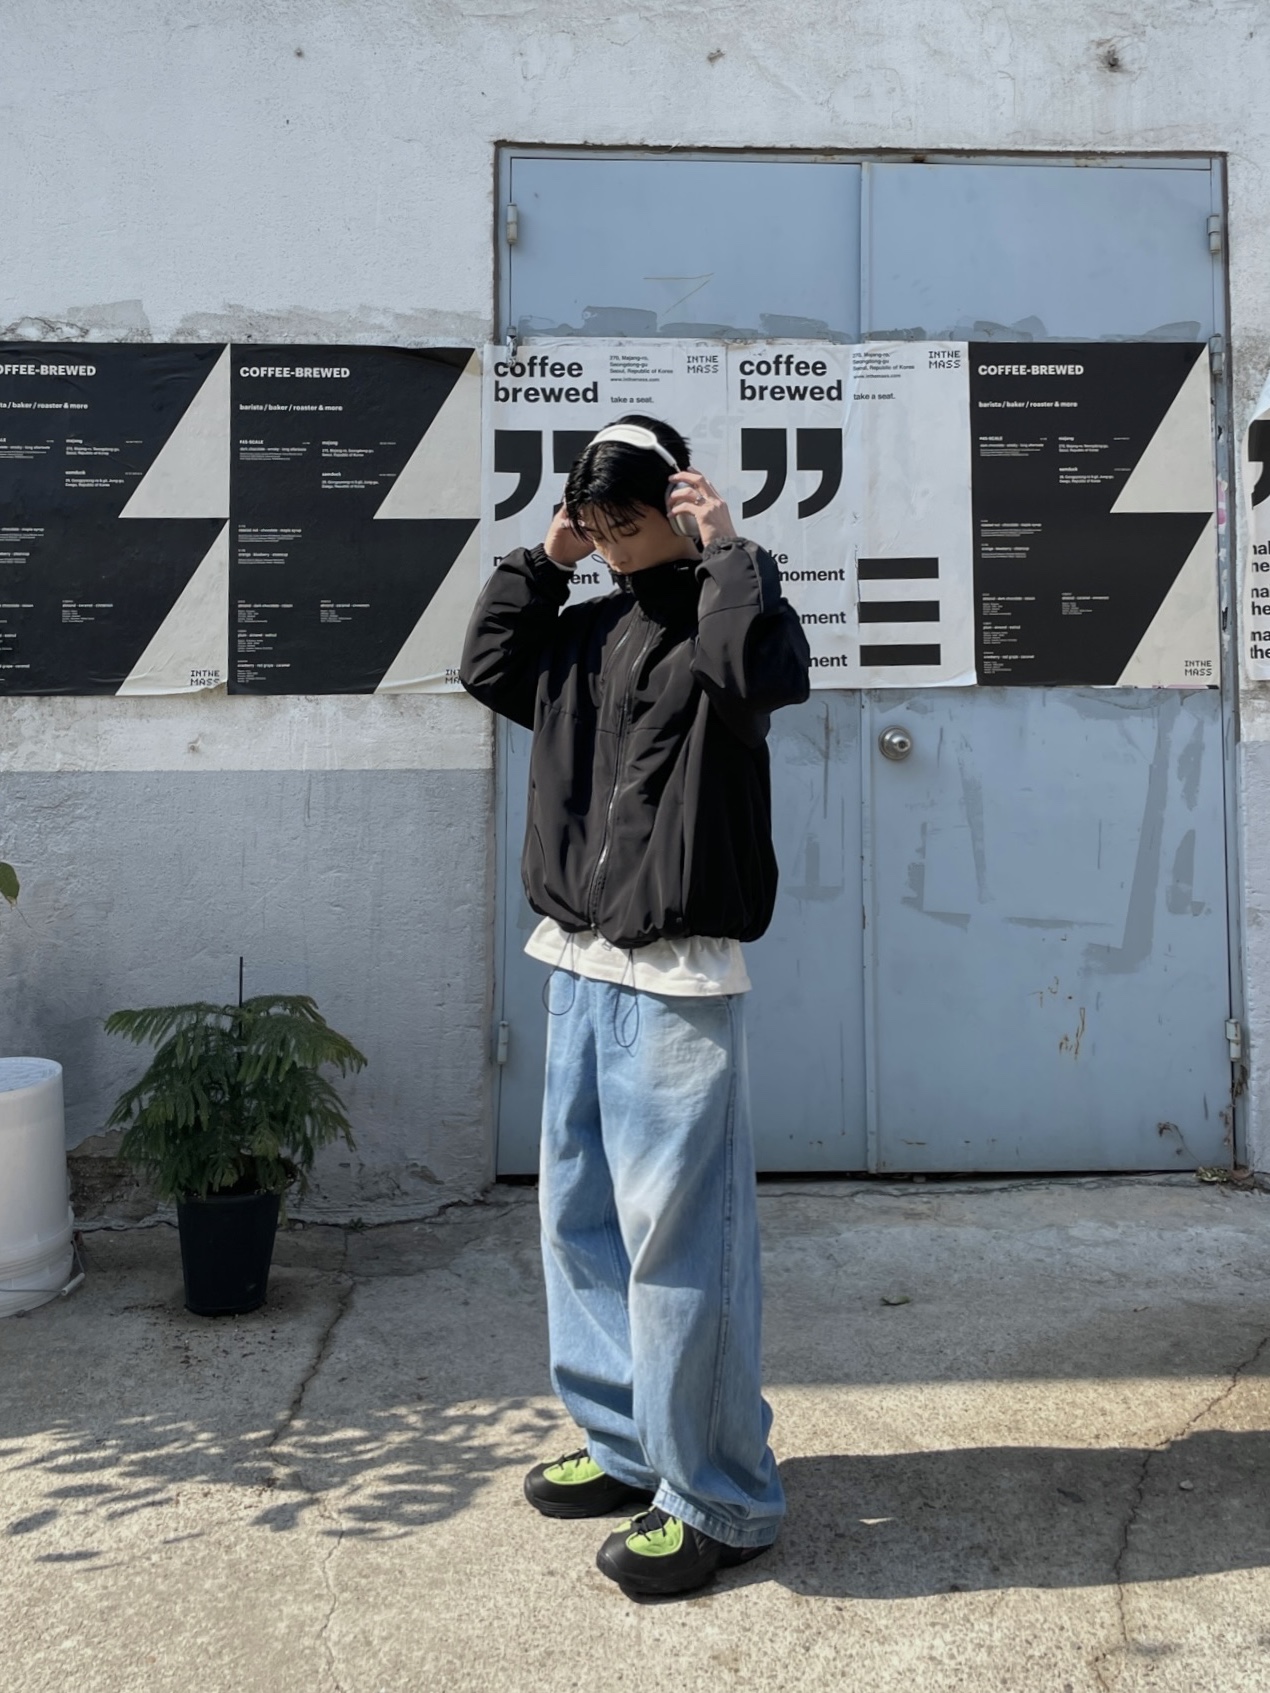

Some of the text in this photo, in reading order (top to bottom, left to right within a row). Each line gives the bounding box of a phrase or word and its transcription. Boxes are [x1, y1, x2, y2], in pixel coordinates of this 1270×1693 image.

[494, 356, 583, 378] coffee
[687, 365, 719, 373] MASS
[739, 355, 827, 376] coffee
[929, 361, 960, 369] MASS
[978, 365, 1084, 376] COFFEE-BREWED
[239, 367, 350, 378] COFFEE-BREWED
[494, 381, 599, 403] brewed
[740, 379, 842, 401] brewed
[268, 403, 288, 411] baker
[769, 550, 788, 564] ke
[571, 572, 600, 584] ent
[802, 612, 846, 624] ment
[1185, 668, 1212, 676] MASS
